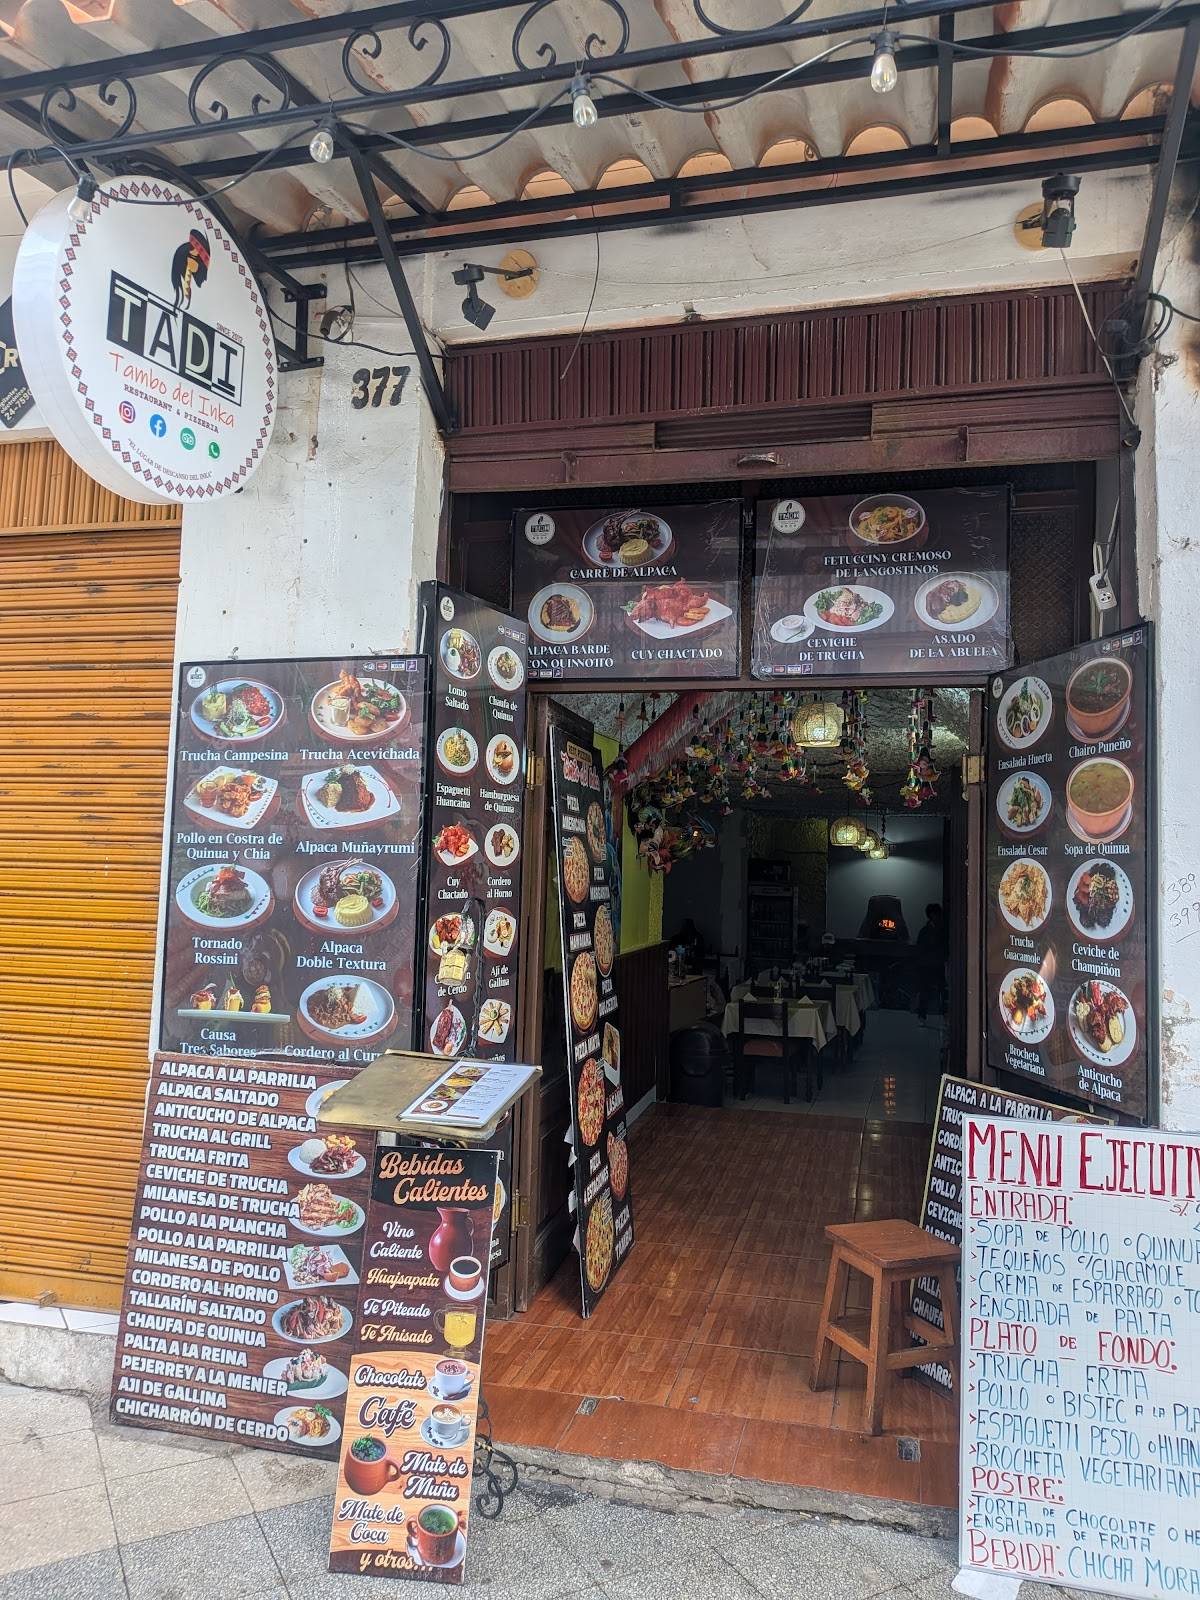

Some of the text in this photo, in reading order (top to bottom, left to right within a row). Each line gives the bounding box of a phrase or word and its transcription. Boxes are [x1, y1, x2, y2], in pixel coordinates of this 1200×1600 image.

[114, 284, 238, 394] TADI
[109, 352, 234, 428] Tambo del Inka
[351, 366, 410, 409] 377
[124, 384, 219, 433] RESTAURANT & PIZZERIA
[136, 448, 154, 466] LUGAR
[154, 463, 162, 472] DE
[163, 465, 188, 480] DESCANSO
[824, 551, 951, 566] FETUCCINY CREMOSO
[612, 568, 629, 579] DE
[630, 566, 677, 578] ALPACA
[835, 564, 939, 578] DE LANGOSTINOS
[807, 637, 857, 648] CEVICHE
[932, 633, 975, 645] ASADO
[631, 648, 722, 660] CUY CHACTADO
[799, 650, 865, 661] DE TRUCHA
[909, 646, 998, 658] DE LA ABUELA
[448, 684, 467, 698] Lomo
[445, 696, 470, 711] Saltado
[489, 695, 518, 711] Chaufa de
[492, 709, 514, 722] Quinua
[180, 749, 289, 761] Trucha Campesina
[300, 748, 420, 760] Trucha Acevichada
[1069, 738, 1131, 759] Chairo Puneño
[998, 753, 1053, 770] Ensalada Huerta
[176, 832, 283, 845] Pollo en Costra de
[296, 841, 415, 854] Alpaca Muñayrumi
[186, 848, 270, 861] Quinua y Chia
[997, 845, 1048, 857] Ensalada Cesar
[1064, 843, 1130, 857] Sopa de Quinua
[447, 877, 460, 888] Cuy
[487, 877, 511, 887] Cordero
[438, 889, 469, 900] Chactado
[487, 888, 512, 899] al Horno
[192, 937, 242, 949] Tornado
[320, 941, 363, 955] Alpaca
[1010, 935, 1034, 948] Trucha
[195, 952, 239, 965] Rossini
[1004, 949, 1041, 965] Guacamole
[1072, 943, 1120, 960] Ceviche de
[296, 956, 386, 971] Doble Textura
[1071, 959, 1121, 978] Champiñón
[437, 986, 446, 997] de
[200, 1028, 236, 1041] Causa
[210, 1043, 257, 1057] Sabores
[1009, 1044, 1039, 1063] Brocheta
[1004, 1053, 1045, 1077] Vegetariana
[160, 1061, 317, 1090] ALPACA A LA PARRILLA
[1078, 1065, 1122, 1088] Anticucho
[157, 1082, 279, 1107] ALPACA SALTADO
[1079, 1078, 1121, 1102] de Alpaca
[944, 1083, 1053, 1121] ALPACA A LA PARRILLA
[154, 1103, 317, 1132] ANTICUCHO DE ALPACA
[149, 1144, 249, 1169] TRUCHA FRITA
[967, 1121, 1062, 1187] MENU
[378, 1151, 465, 1179] Bebidas
[146, 1164, 288, 1194] CEVICHE DE TRUCHA
[393, 1178, 489, 1205] Calientes
[142, 1185, 301, 1218] MILANESA DE TRUCHA
[970, 1186, 1073, 1225] ENTRADA:
[382, 1221, 415, 1238] Vino
[370, 1242, 423, 1260] Caliente
[366, 1268, 440, 1290] Huajsapata
[129, 1290, 266, 1325] TALLARÍN SALTADO
[363, 1299, 431, 1318] Te Piteado
[979, 1295, 1173, 1336] ENSALADA DE PALTA
[360, 1324, 433, 1344] Te Anisado
[970, 1318, 1178, 1371] PLATO DE FONDO:
[355, 1365, 426, 1389] Chocolate
[977, 1352, 1059, 1388] TRUCHA
[1086, 1365, 1149, 1400] FRITA
[116, 1398, 290, 1442] CHICHARRÓN DE CERDO
[358, 1395, 417, 1437] Café
[401, 1451, 469, 1476] Mate de
[976, 1441, 1065, 1479] BROCHETA
[403, 1475, 459, 1500] Muña
[971, 1467, 1065, 1502] POSTRE:
[338, 1499, 404, 1523] Mate de
[350, 1522, 388, 1543] Coca
[973, 1513, 1151, 1551] ENSALADA DE FRUTA
[360, 1551, 371, 1571] y
[967, 1529, 1064, 1577] BEBIDA:
[1068, 1546, 1133, 1582] CHICHA
